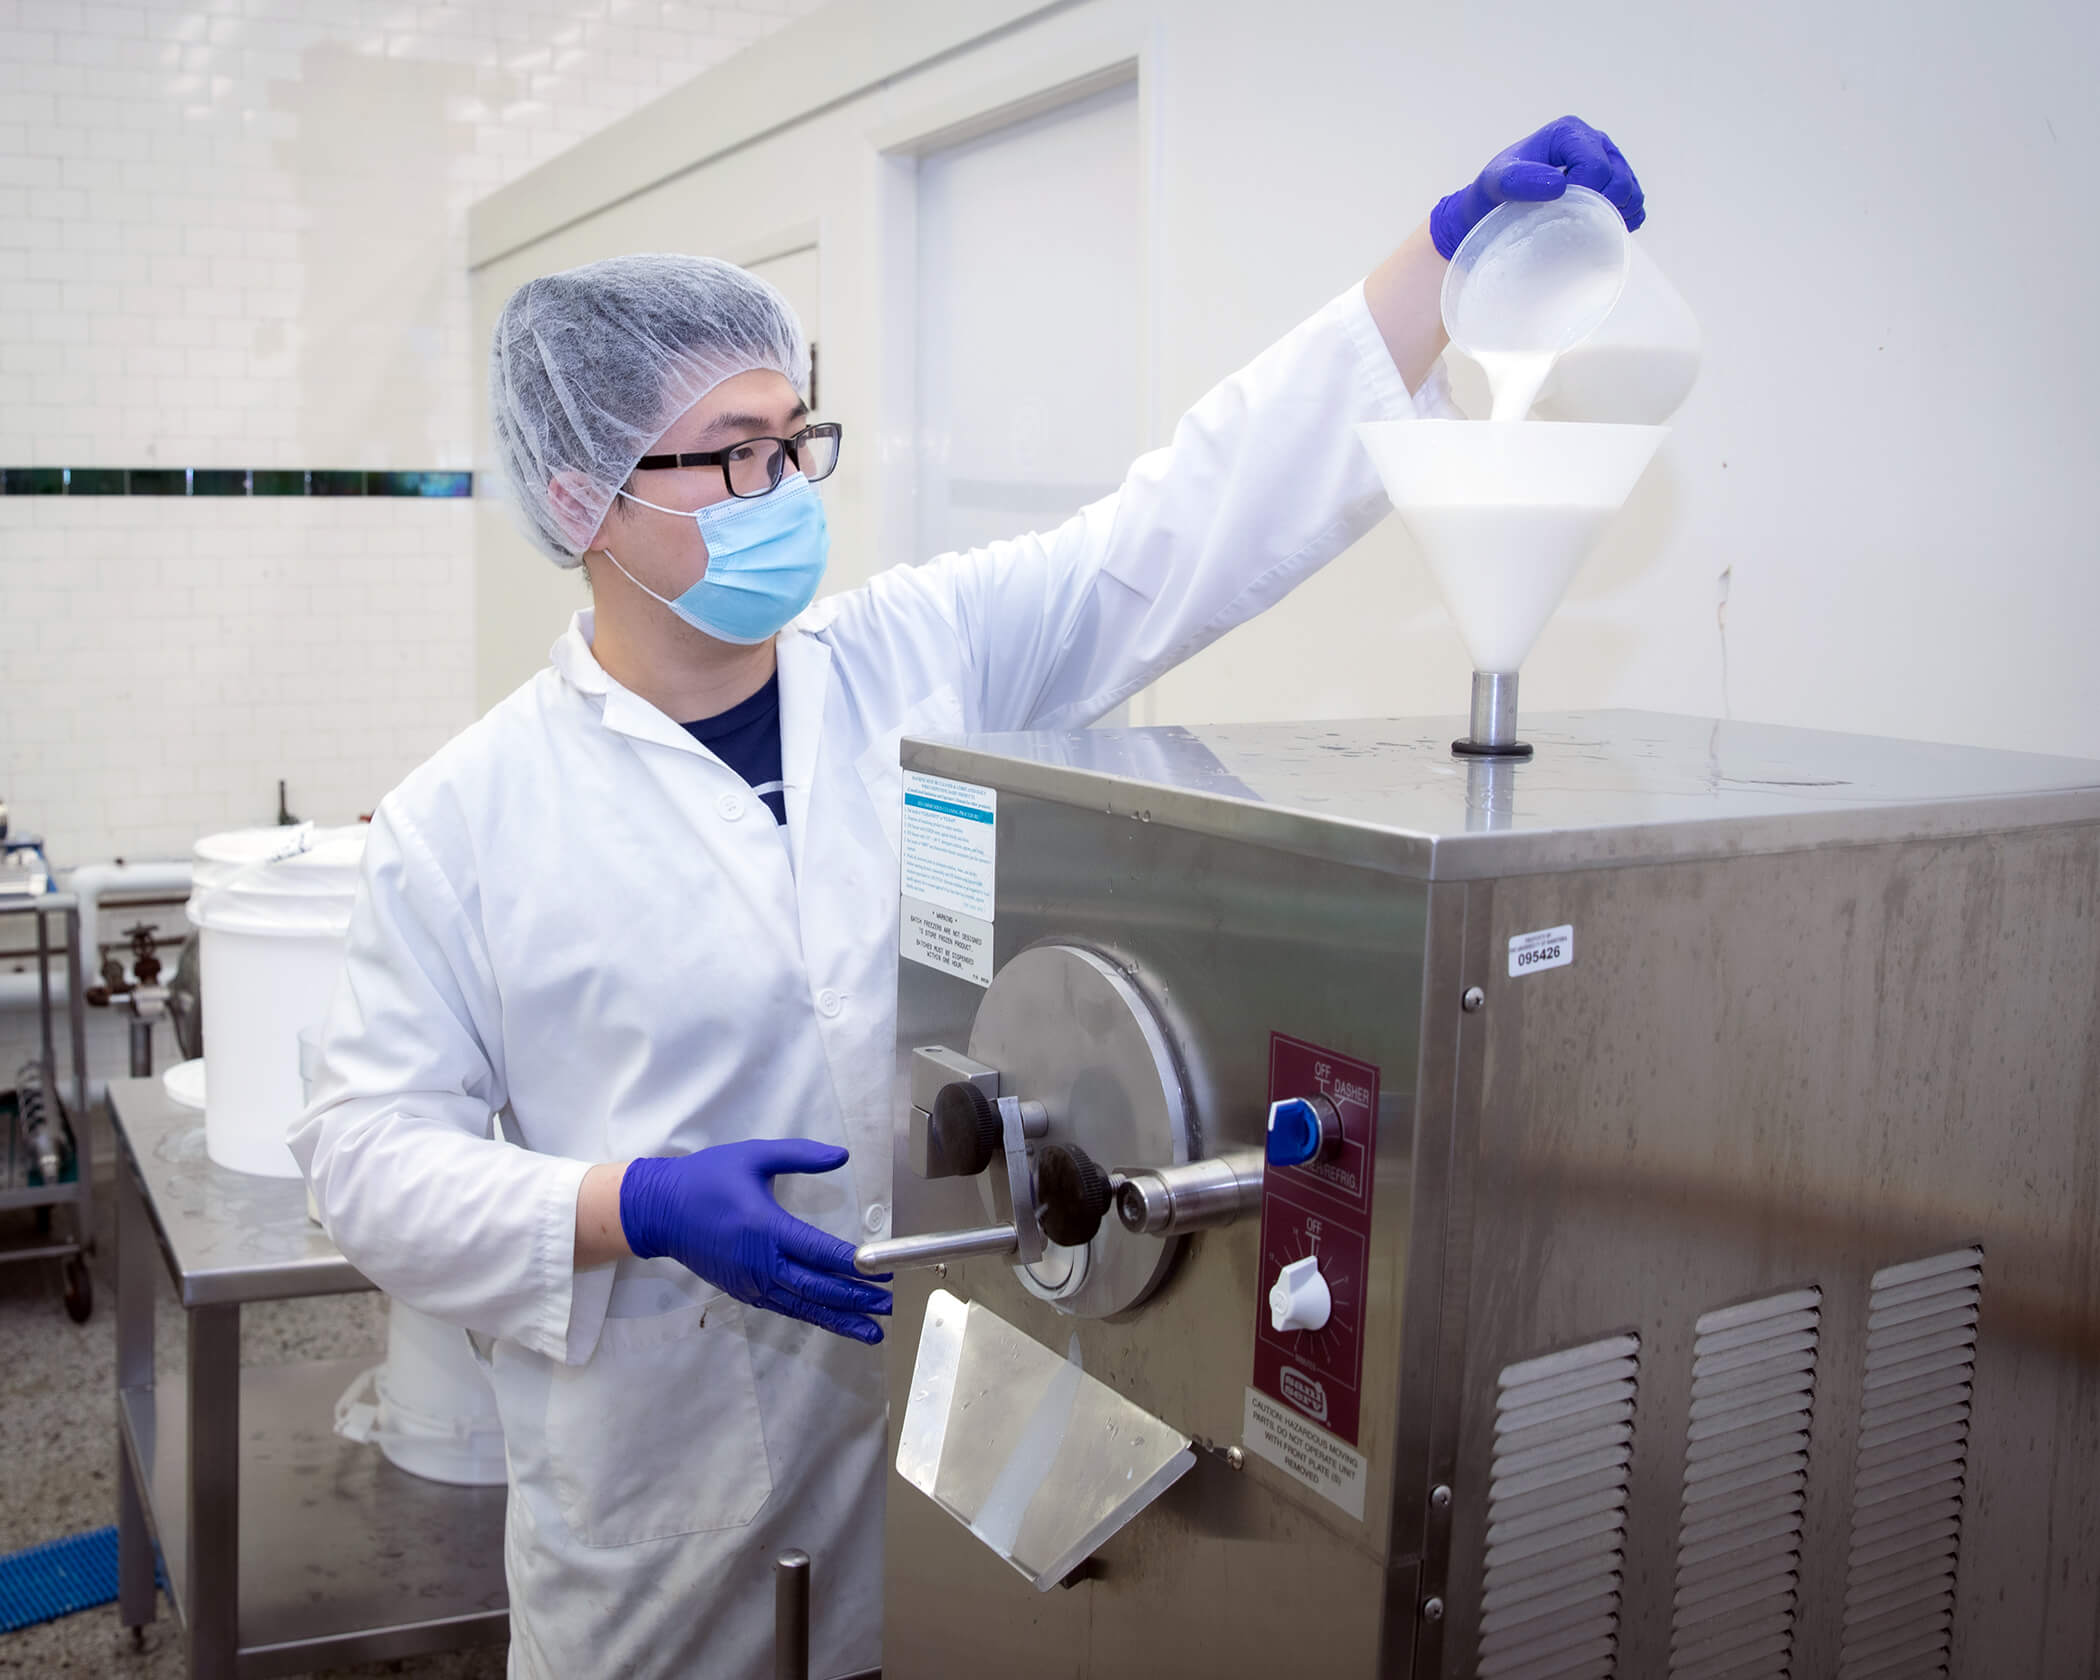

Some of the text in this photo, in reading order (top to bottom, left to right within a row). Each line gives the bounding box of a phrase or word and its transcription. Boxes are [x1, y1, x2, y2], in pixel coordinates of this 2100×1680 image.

[1518, 945, 1560, 966] 095426
[1315, 1061, 1331, 1079] OFF
[1334, 1078, 1369, 1103] DASHER
[1306, 1217, 1323, 1234] OFF
[1264, 1431, 1282, 1448] WITH
[1283, 1442, 1306, 1462] FRONT
[1308, 1456, 1330, 1479] PLATE
[1277, 1425, 1288, 1438] DO
[1289, 1432, 1303, 1446] NOT
[1305, 1442, 1337, 1468] OPERATE
[1339, 1465, 1355, 1480] UNIT
[1285, 1416, 1328, 1449] HAZARDOUS
[1329, 1443, 1358, 1468] MOVING
[1285, 1456, 1320, 1484] REMOVED
